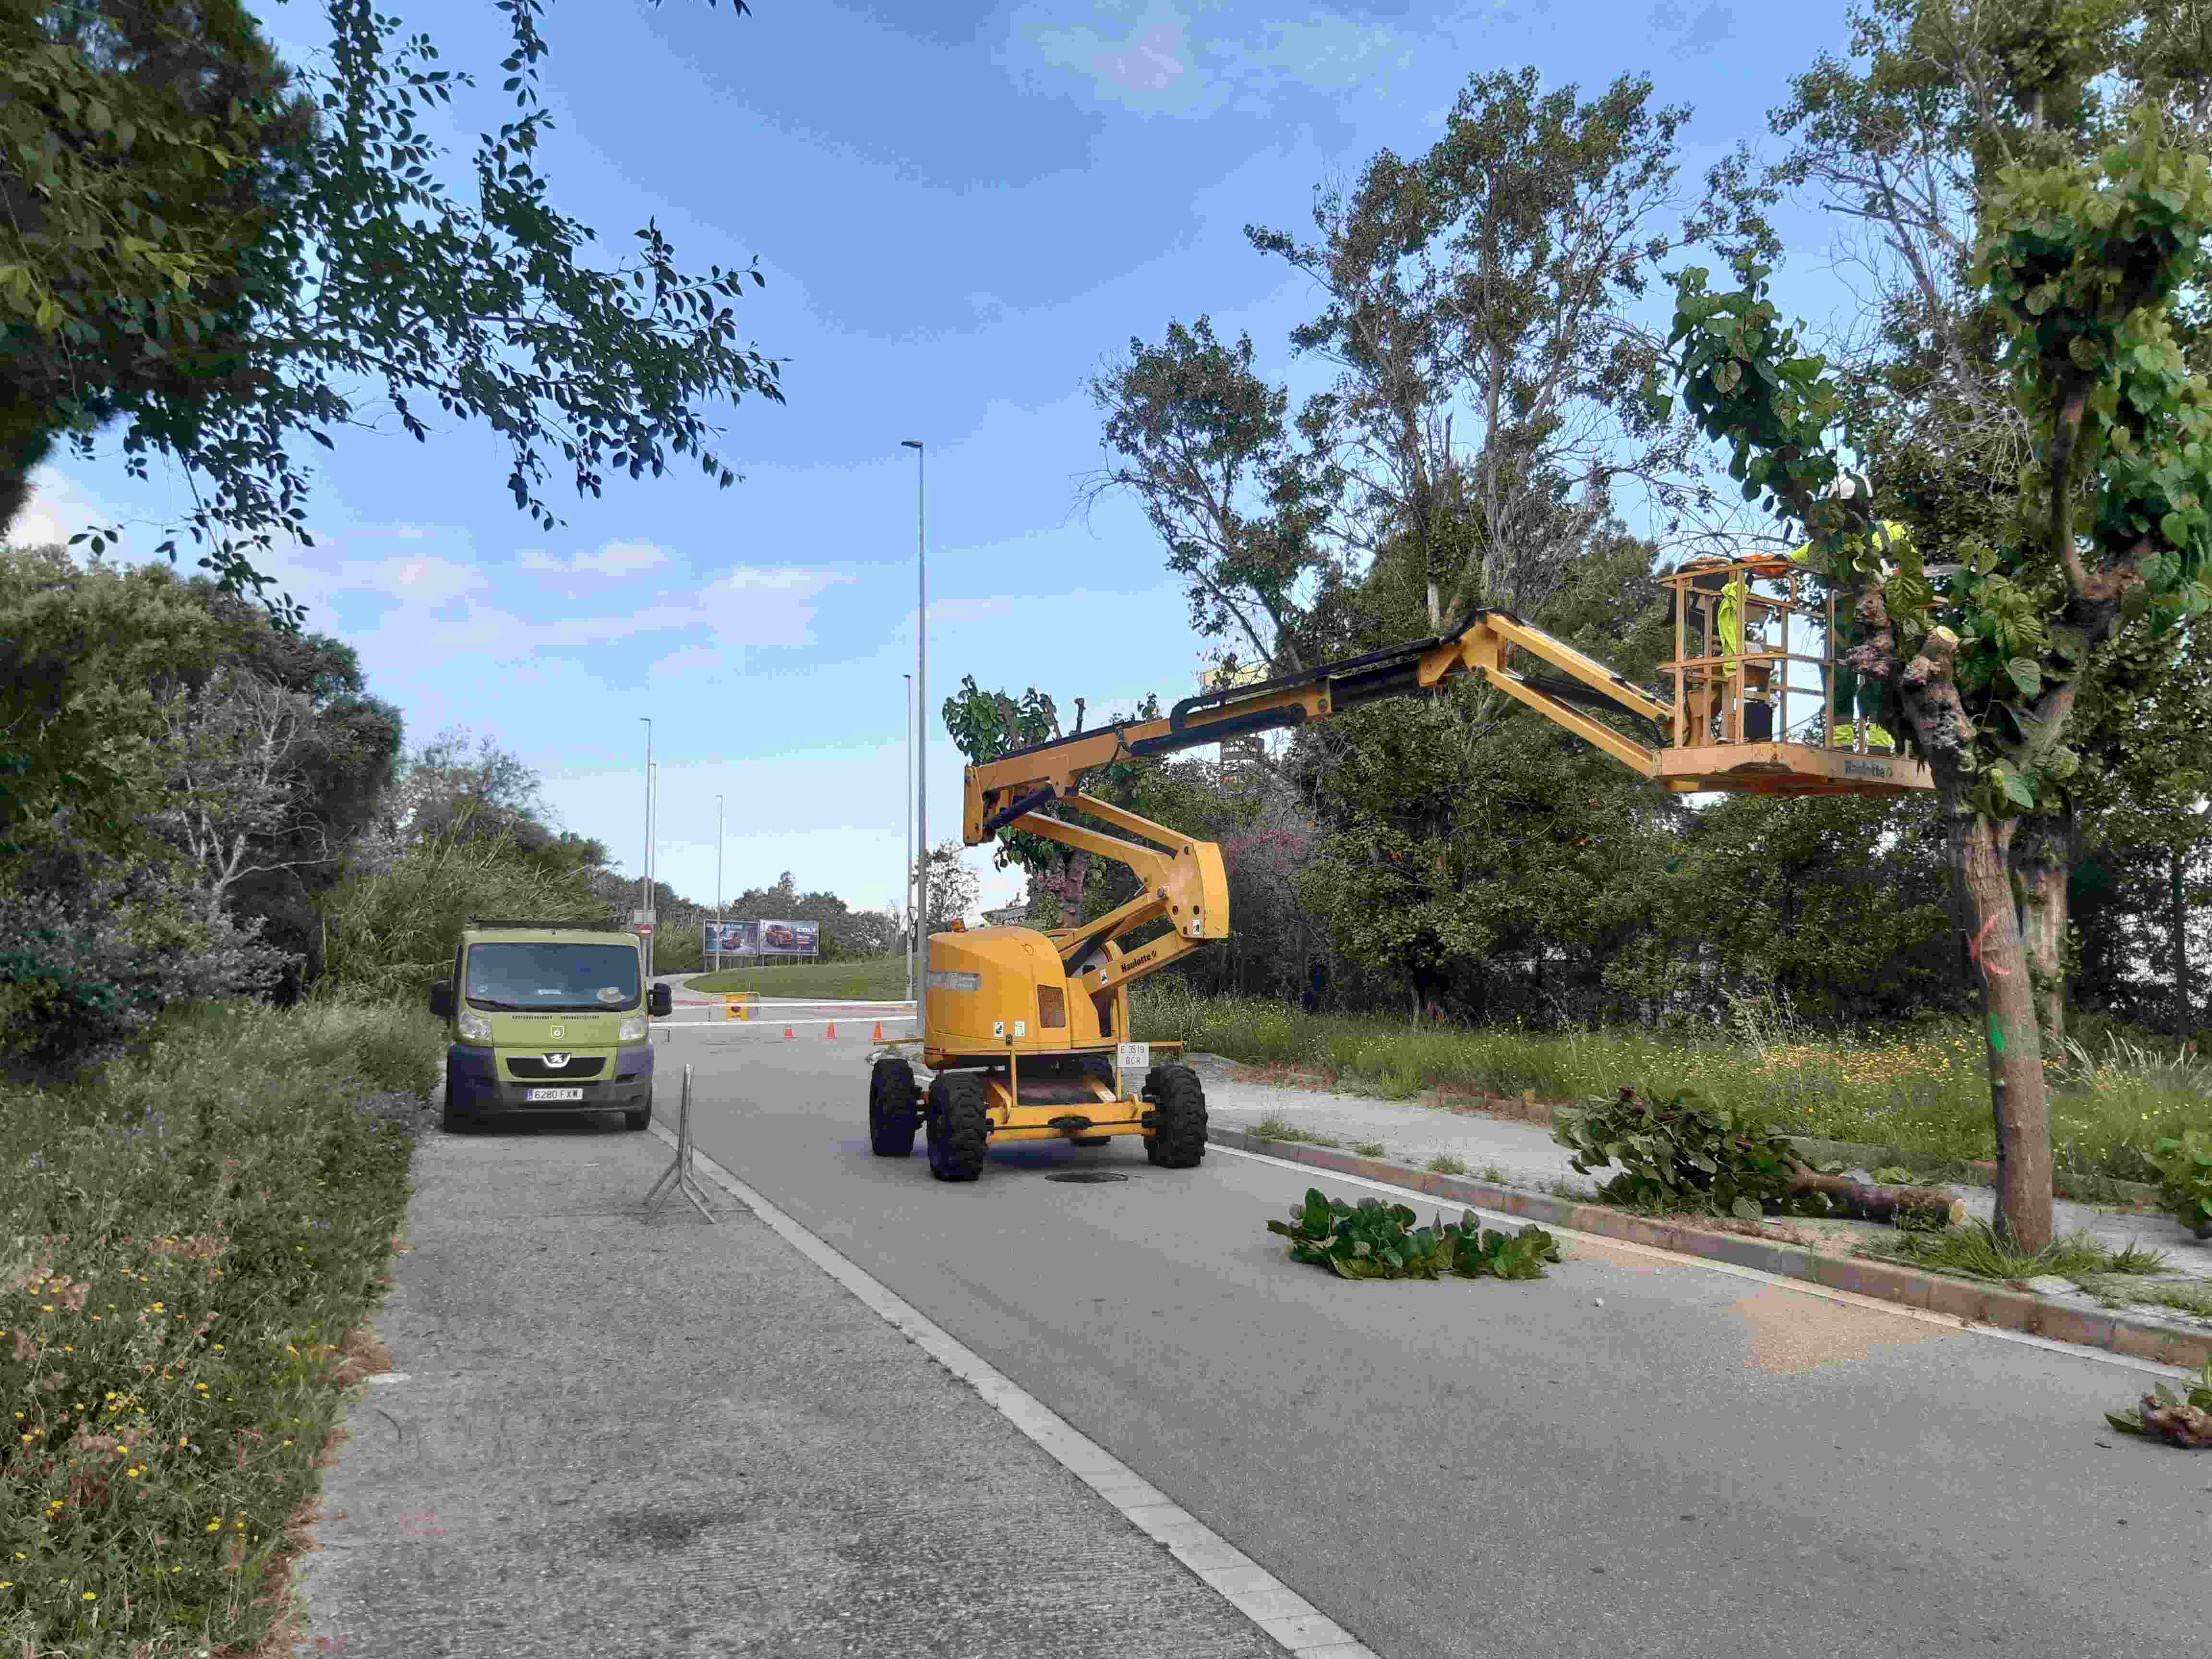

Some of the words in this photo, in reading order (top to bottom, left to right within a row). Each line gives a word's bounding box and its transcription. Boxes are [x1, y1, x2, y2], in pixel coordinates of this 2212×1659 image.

[1121, 954, 1151, 973] Haulotte
[1126, 1056, 1141, 1064] BCR
[534, 1090, 557, 1099] 6280
